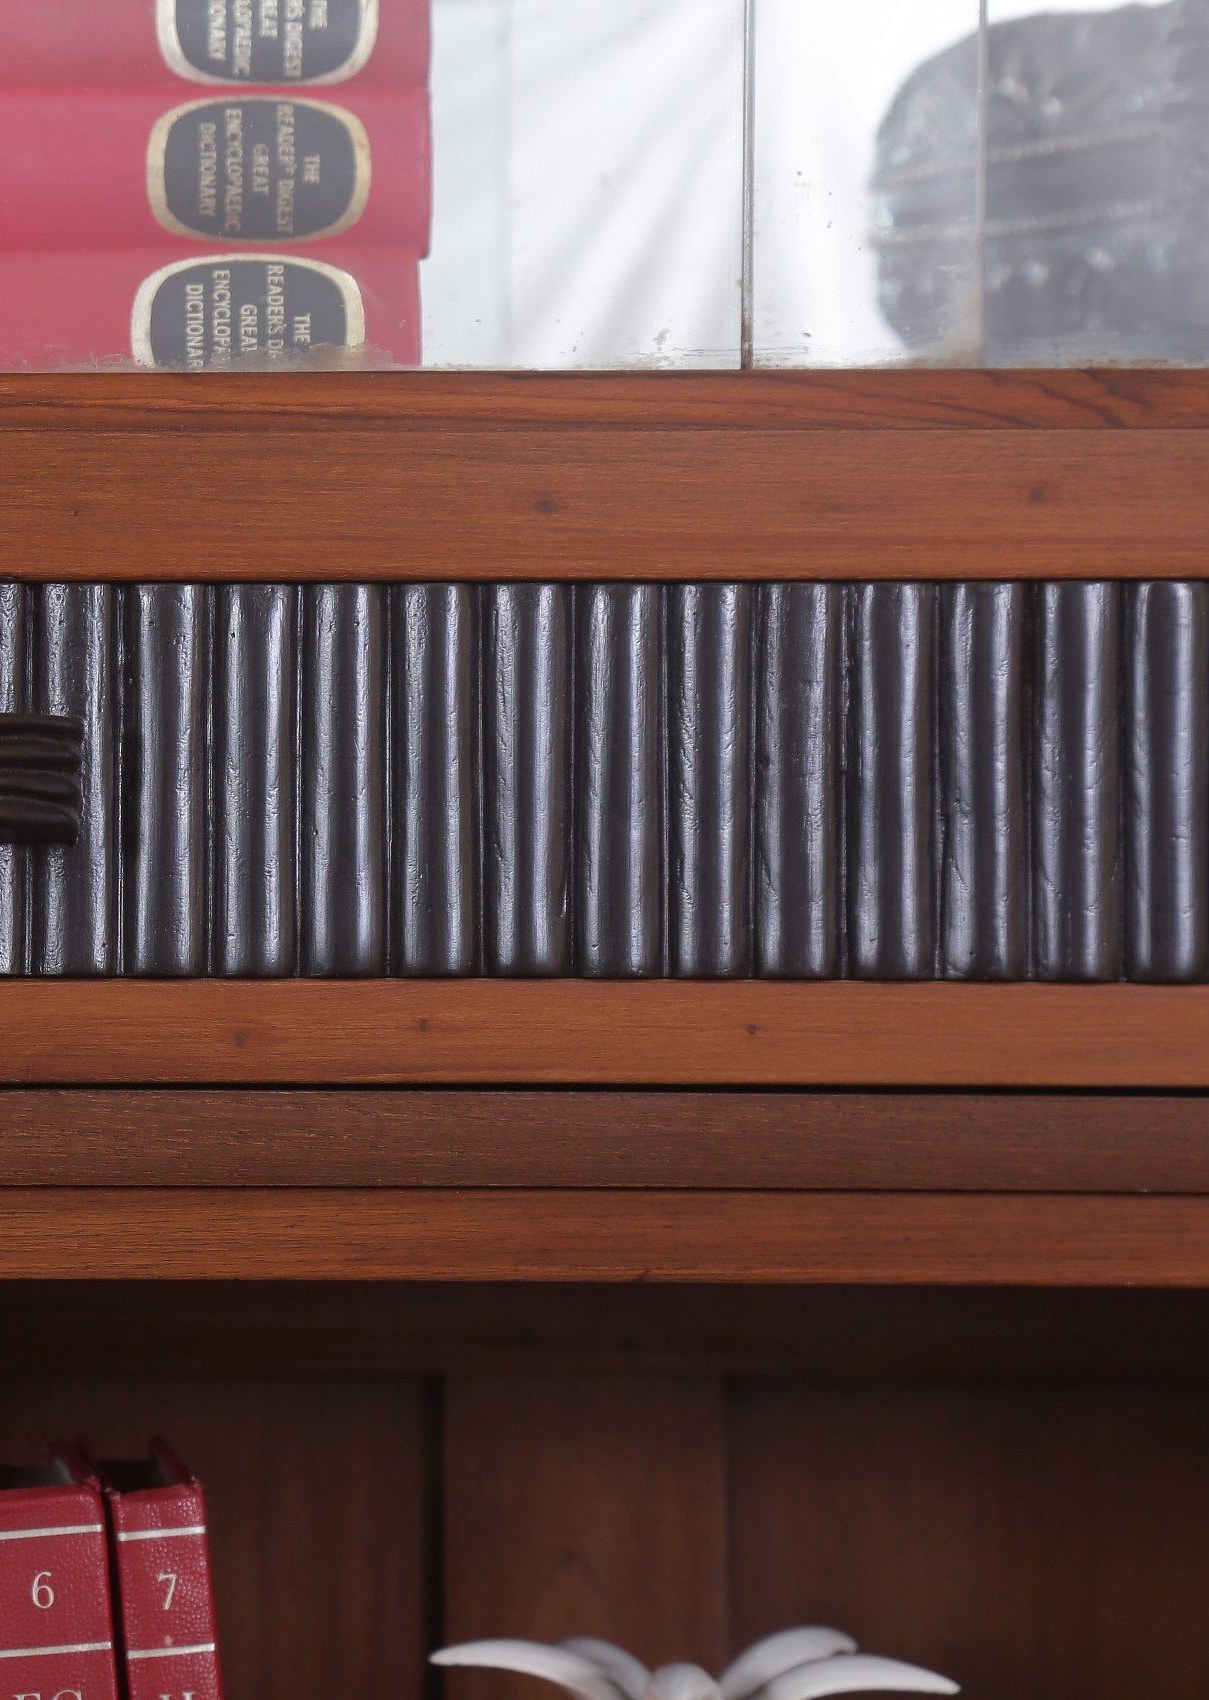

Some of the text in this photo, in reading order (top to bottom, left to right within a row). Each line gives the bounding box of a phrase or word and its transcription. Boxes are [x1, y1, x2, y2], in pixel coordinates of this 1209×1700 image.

[260, 0, 278, 40] REAT
[199, 122, 216, 216] DICTIONARY
[224, 108, 242, 232] ENCYCLOPAEDIC
[252, 144, 269, 195] GREAT
[304, 154, 320, 184] THE
[276, 180, 294, 234] DIGEST
[266, 264, 286, 333] READER'S
[185, 284, 204, 368] DICTIONAR
[294, 313, 311, 345] THE
[31, 1571, 55, 1609] 6
[156, 1573, 178, 1610] 7
